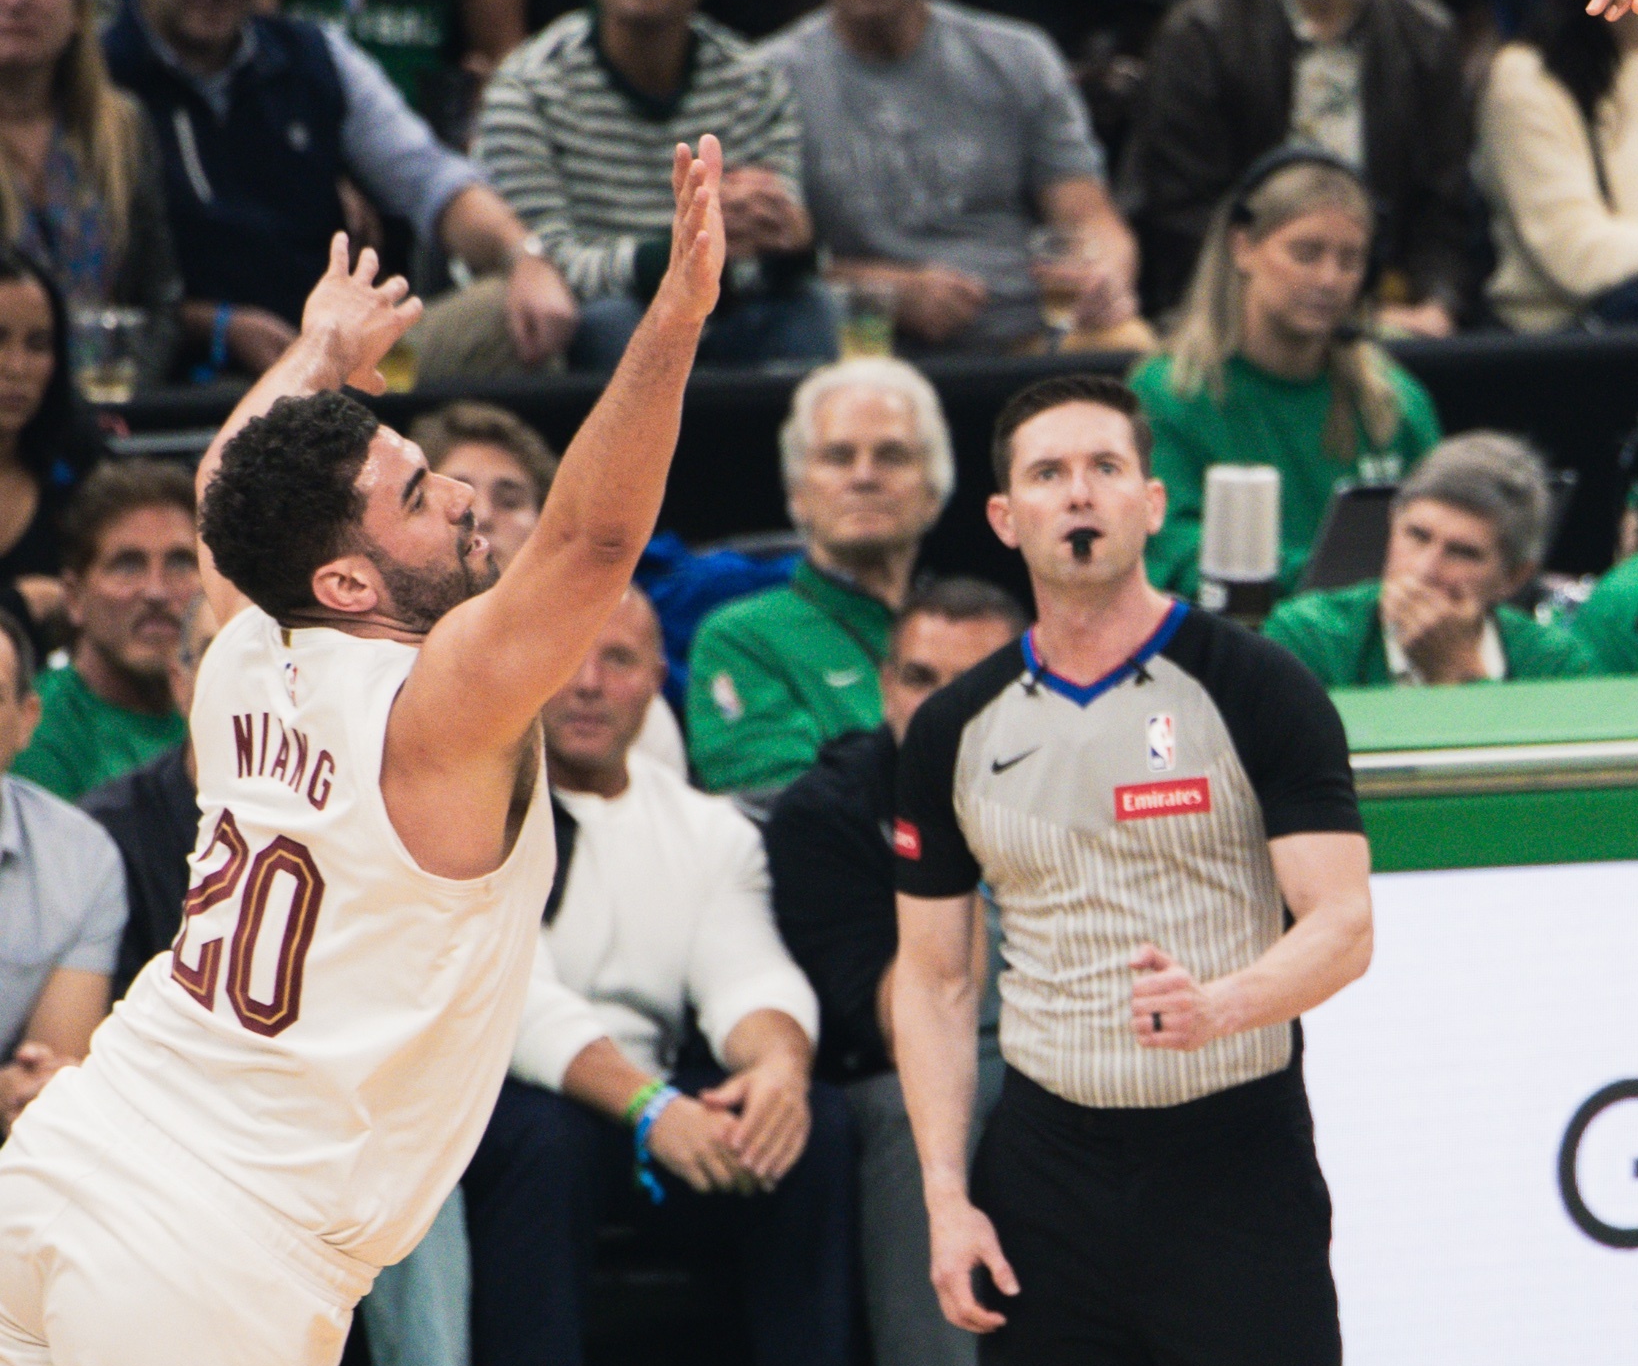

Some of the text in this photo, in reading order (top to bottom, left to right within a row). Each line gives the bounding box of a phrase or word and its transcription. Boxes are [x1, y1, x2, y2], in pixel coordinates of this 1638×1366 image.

[232, 712, 336, 811] NIANG
[1122, 789, 1203, 812] Emirates
[171, 806, 326, 1038] 20
